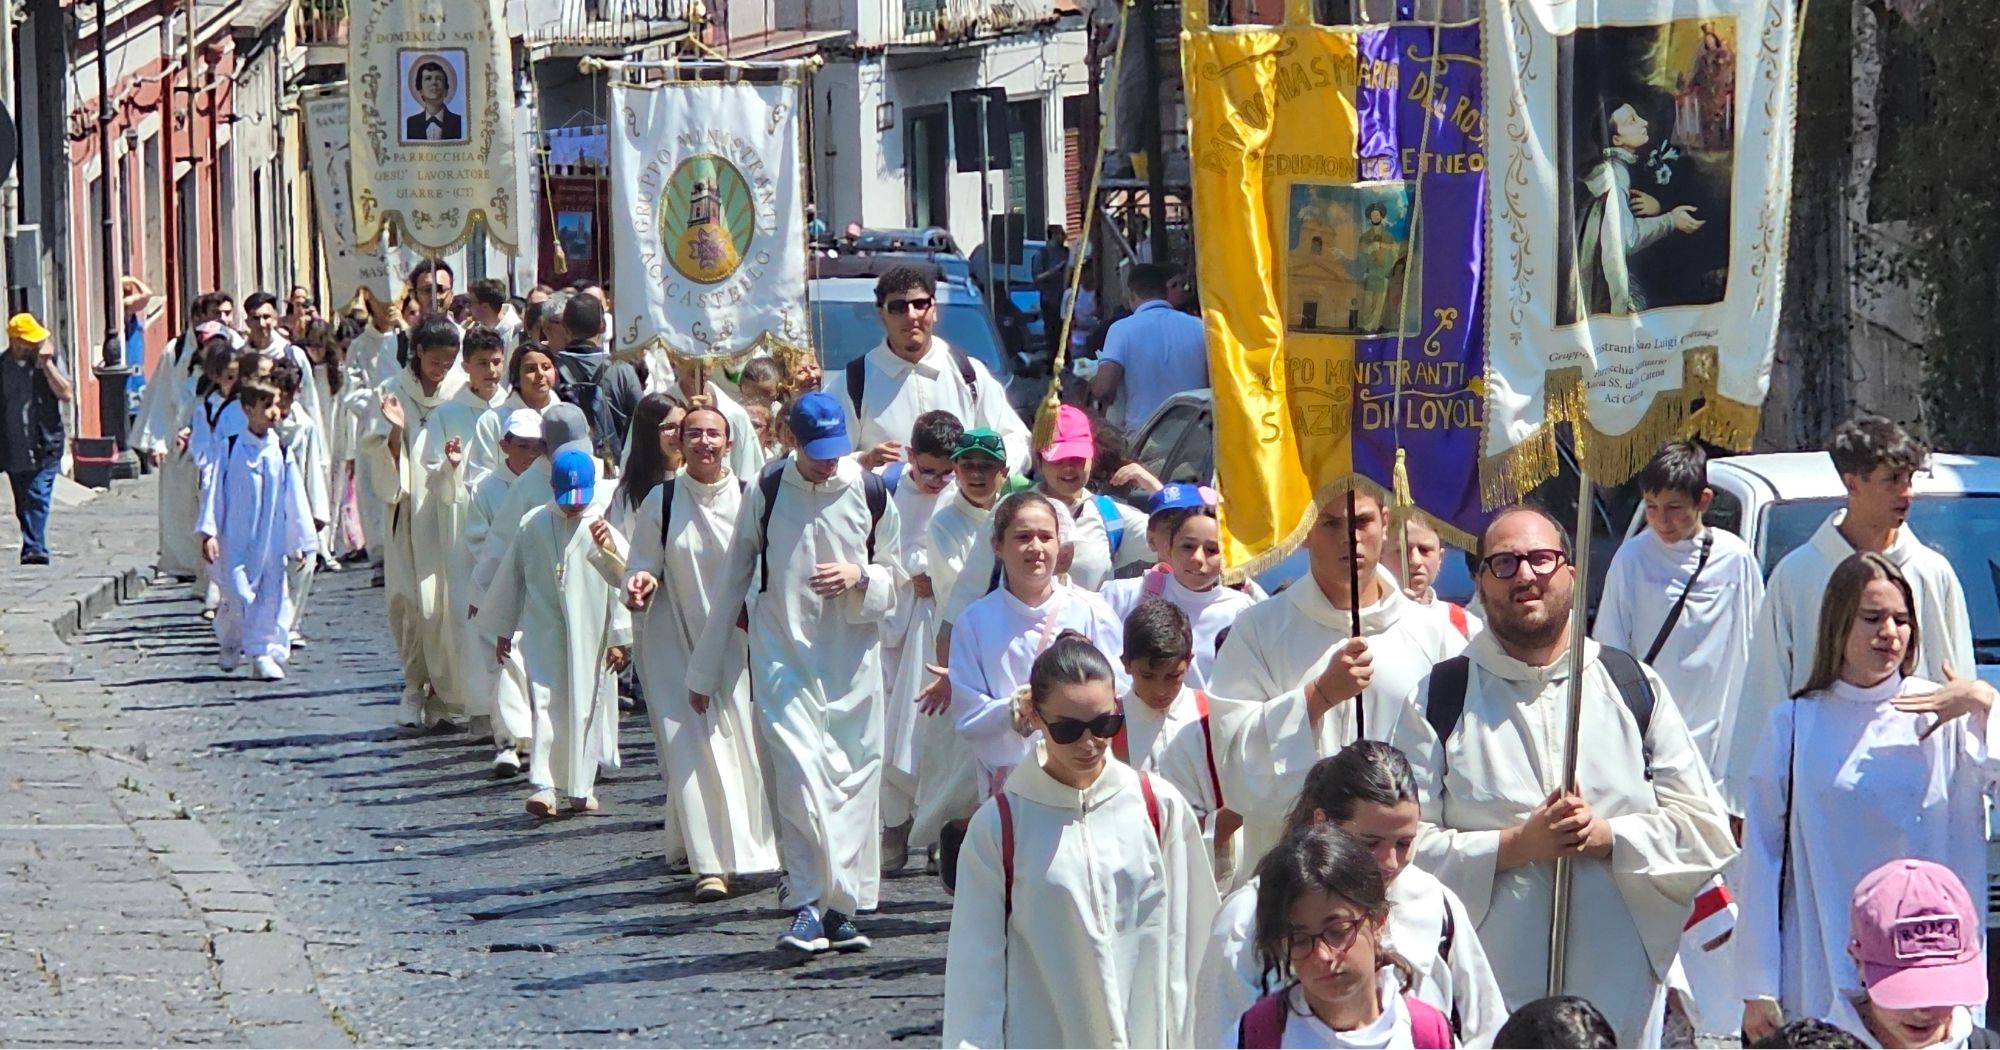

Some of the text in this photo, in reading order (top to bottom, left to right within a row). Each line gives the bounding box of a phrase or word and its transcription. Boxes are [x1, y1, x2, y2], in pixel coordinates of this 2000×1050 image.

[418, 13, 446, 24] SAN
[393, 151, 475, 163] PARROCCHIA
[1401, 148, 1484, 174] ETNEO
[417, 169, 490, 181] LAVORATORE
[396, 188, 444, 199] GIARRE
[634, 149, 672, 234] GRUPPO
[1654, 336, 1677, 351] Luigi
[1325, 359, 1464, 386] MINISTRANTI
[1604, 393, 1620, 404] Aci
[1901, 921, 1958, 942] ROMA
